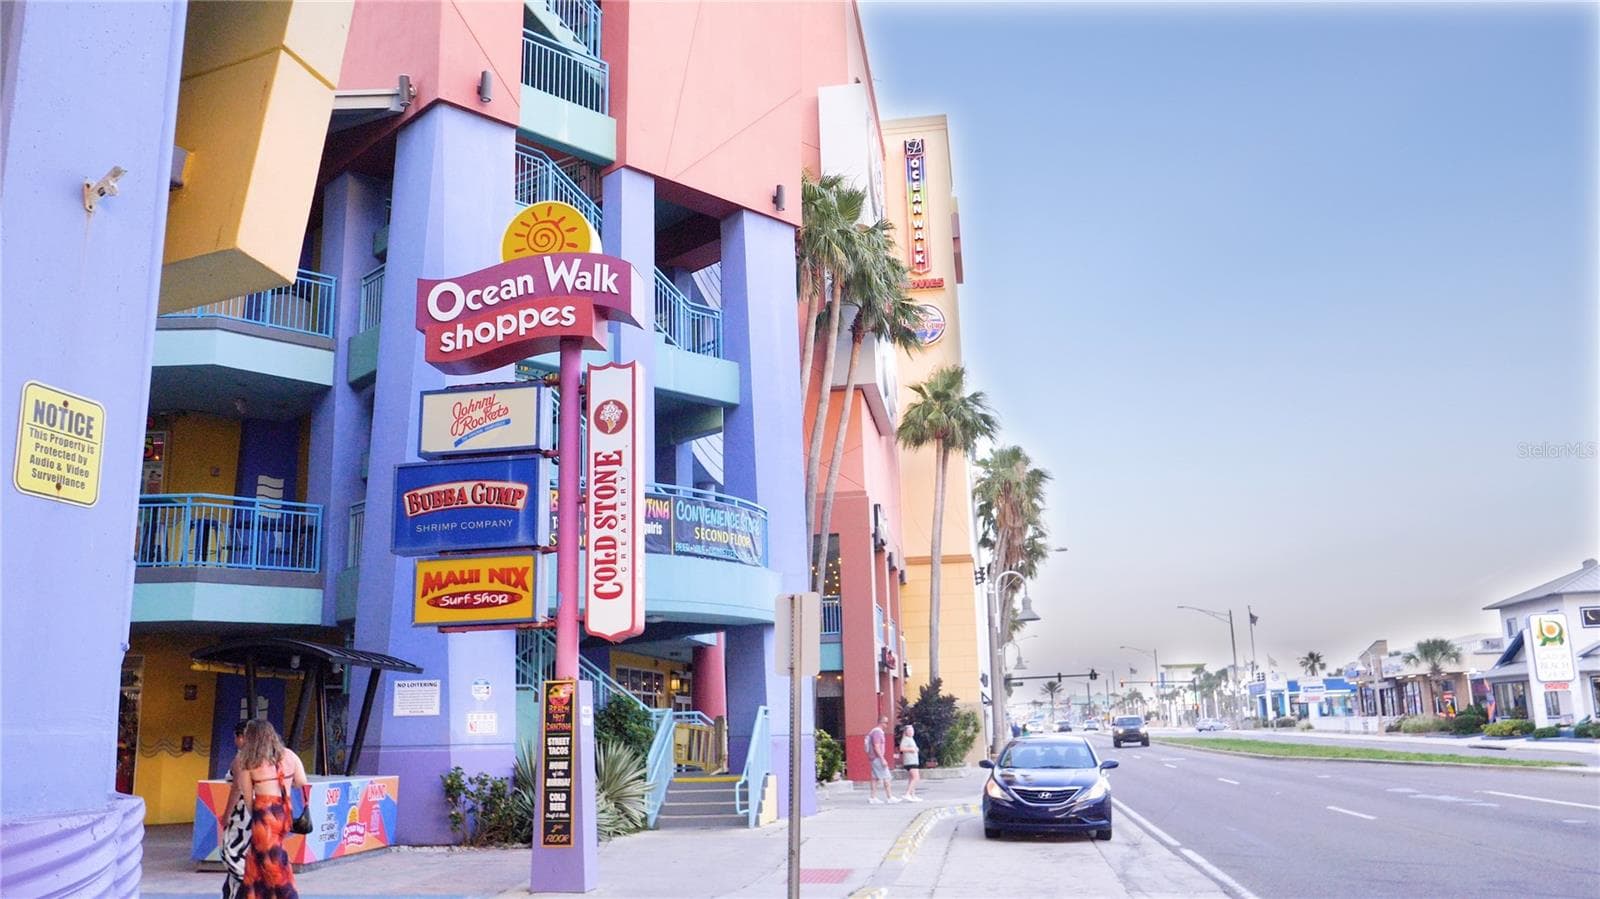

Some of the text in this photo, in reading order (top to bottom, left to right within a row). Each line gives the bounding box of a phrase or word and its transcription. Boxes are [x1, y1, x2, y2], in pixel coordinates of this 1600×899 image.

[911, 158, 922, 215] OCEAN
[912, 220, 925, 264] WALK
[427, 256, 619, 322] Ocean Walk
[440, 305, 576, 353] shoppes
[33, 399, 95, 439] NOTICE
[451, 394, 500, 434] Johnny
[458, 405, 509, 436] Rockets
[29, 427, 95, 455] This Property is
[34, 442, 88, 466] Protected by
[29, 454, 89, 478] Audio & Video
[31, 468, 86, 489] Surveillance
[407, 486, 468, 515] BUBBA
[471, 483, 525, 507] GUMP
[646, 498, 670, 520] TINA
[415, 519, 513, 533] SHRIMP COMPANY
[594, 450, 623, 600] COLD STONE
[694, 527, 729, 544] SECOND
[421, 567, 530, 599] MAUI NIX
[439, 592, 509, 607] Surf Shop
[548, 746, 569, 755] TACOS
[549, 793, 567, 802] COLD
